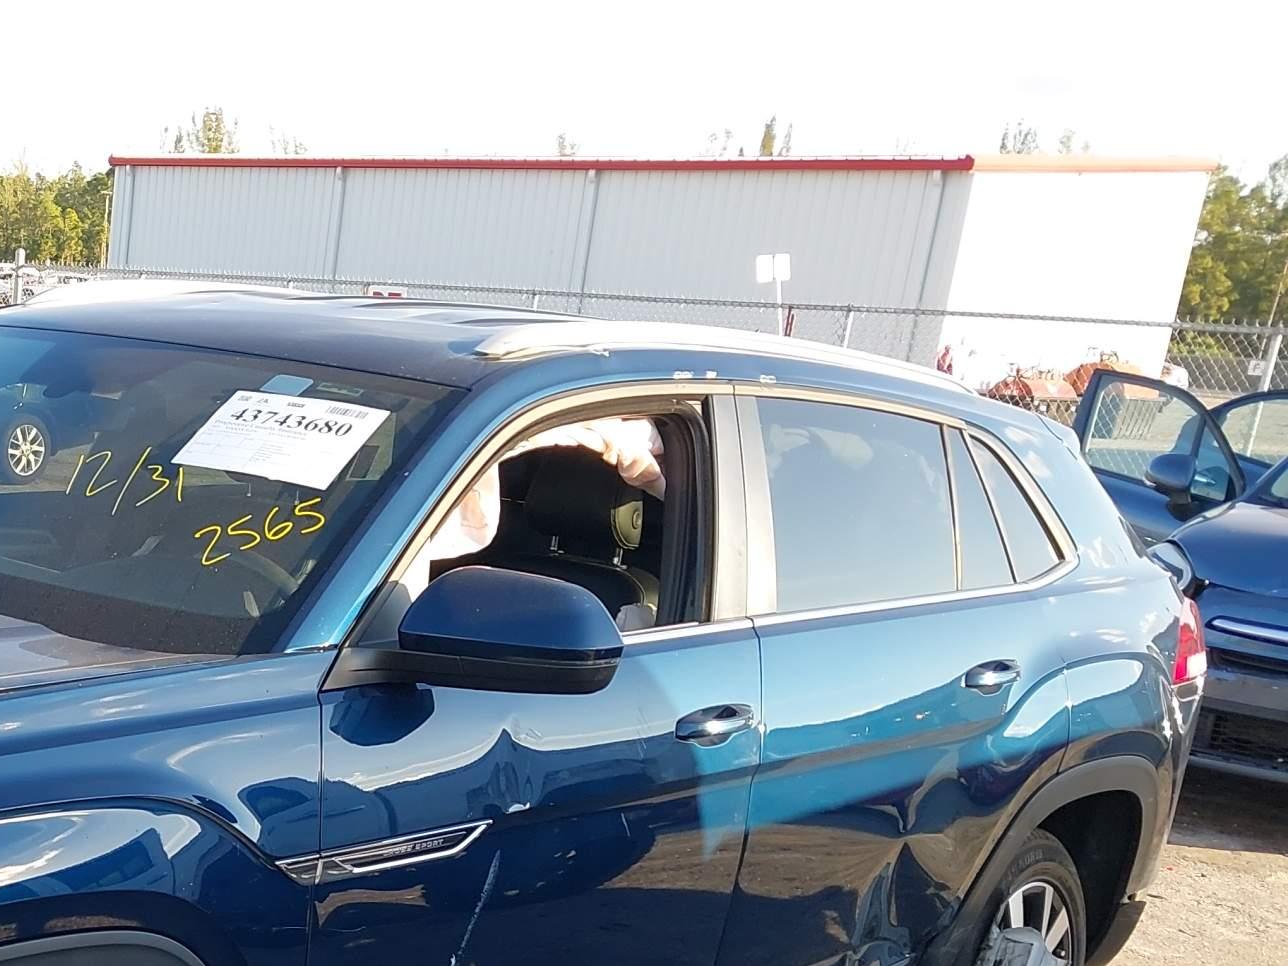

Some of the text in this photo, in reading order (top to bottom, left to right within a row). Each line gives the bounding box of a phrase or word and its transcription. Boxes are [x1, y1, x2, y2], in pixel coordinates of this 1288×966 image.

[230, 406, 353, 437] 43743680
[65, 446, 184, 516] 12/31
[193, 497, 326, 567] 2565
